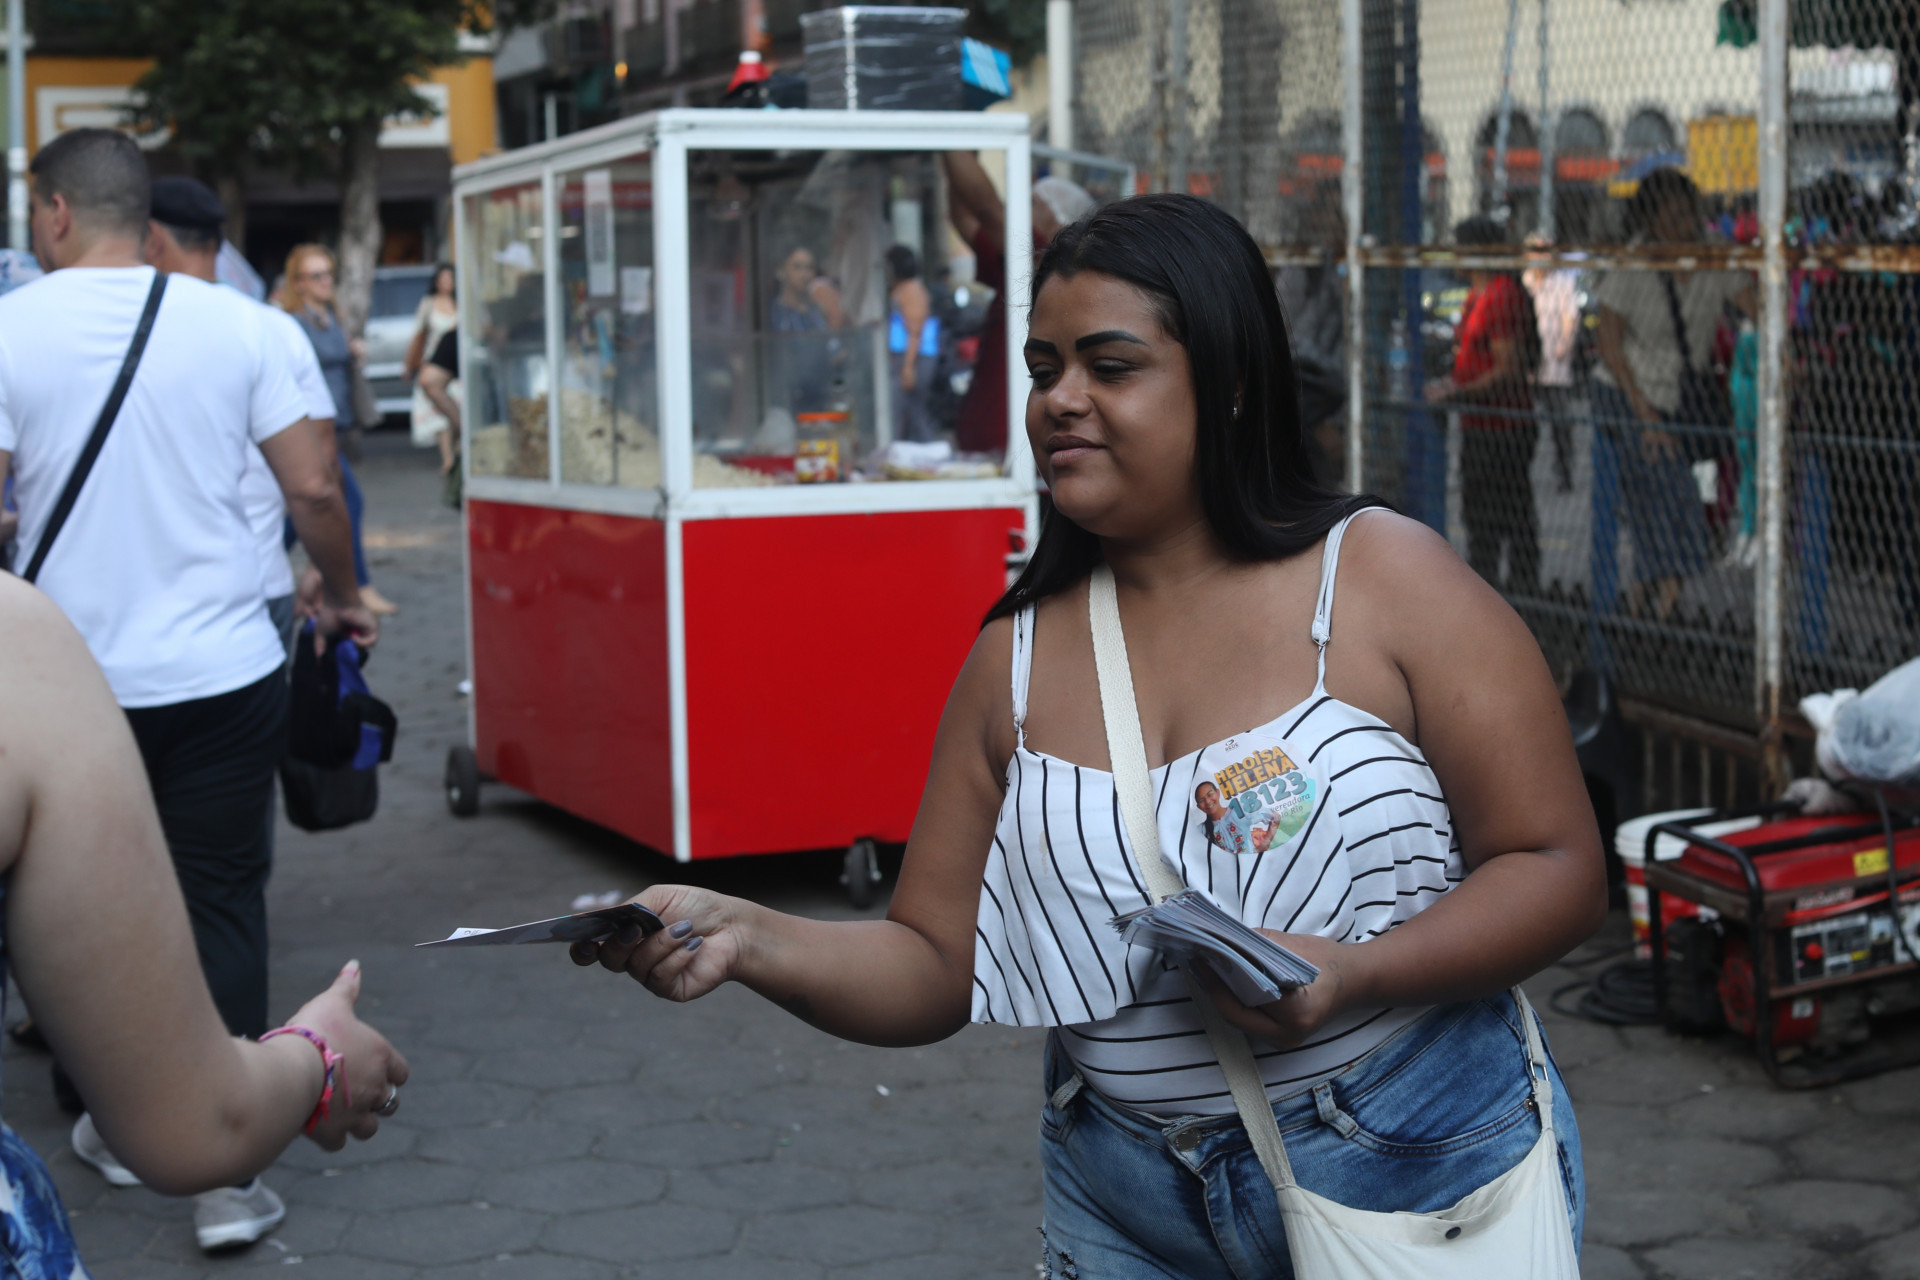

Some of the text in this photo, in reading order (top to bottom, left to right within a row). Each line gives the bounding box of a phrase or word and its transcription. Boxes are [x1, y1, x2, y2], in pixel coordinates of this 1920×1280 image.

[1220, 756, 1298, 800] HELENA
[1229, 772, 1307, 819] 18123
[1271, 793, 1311, 813] vereadora
[1290, 805, 1304, 815] Rio
